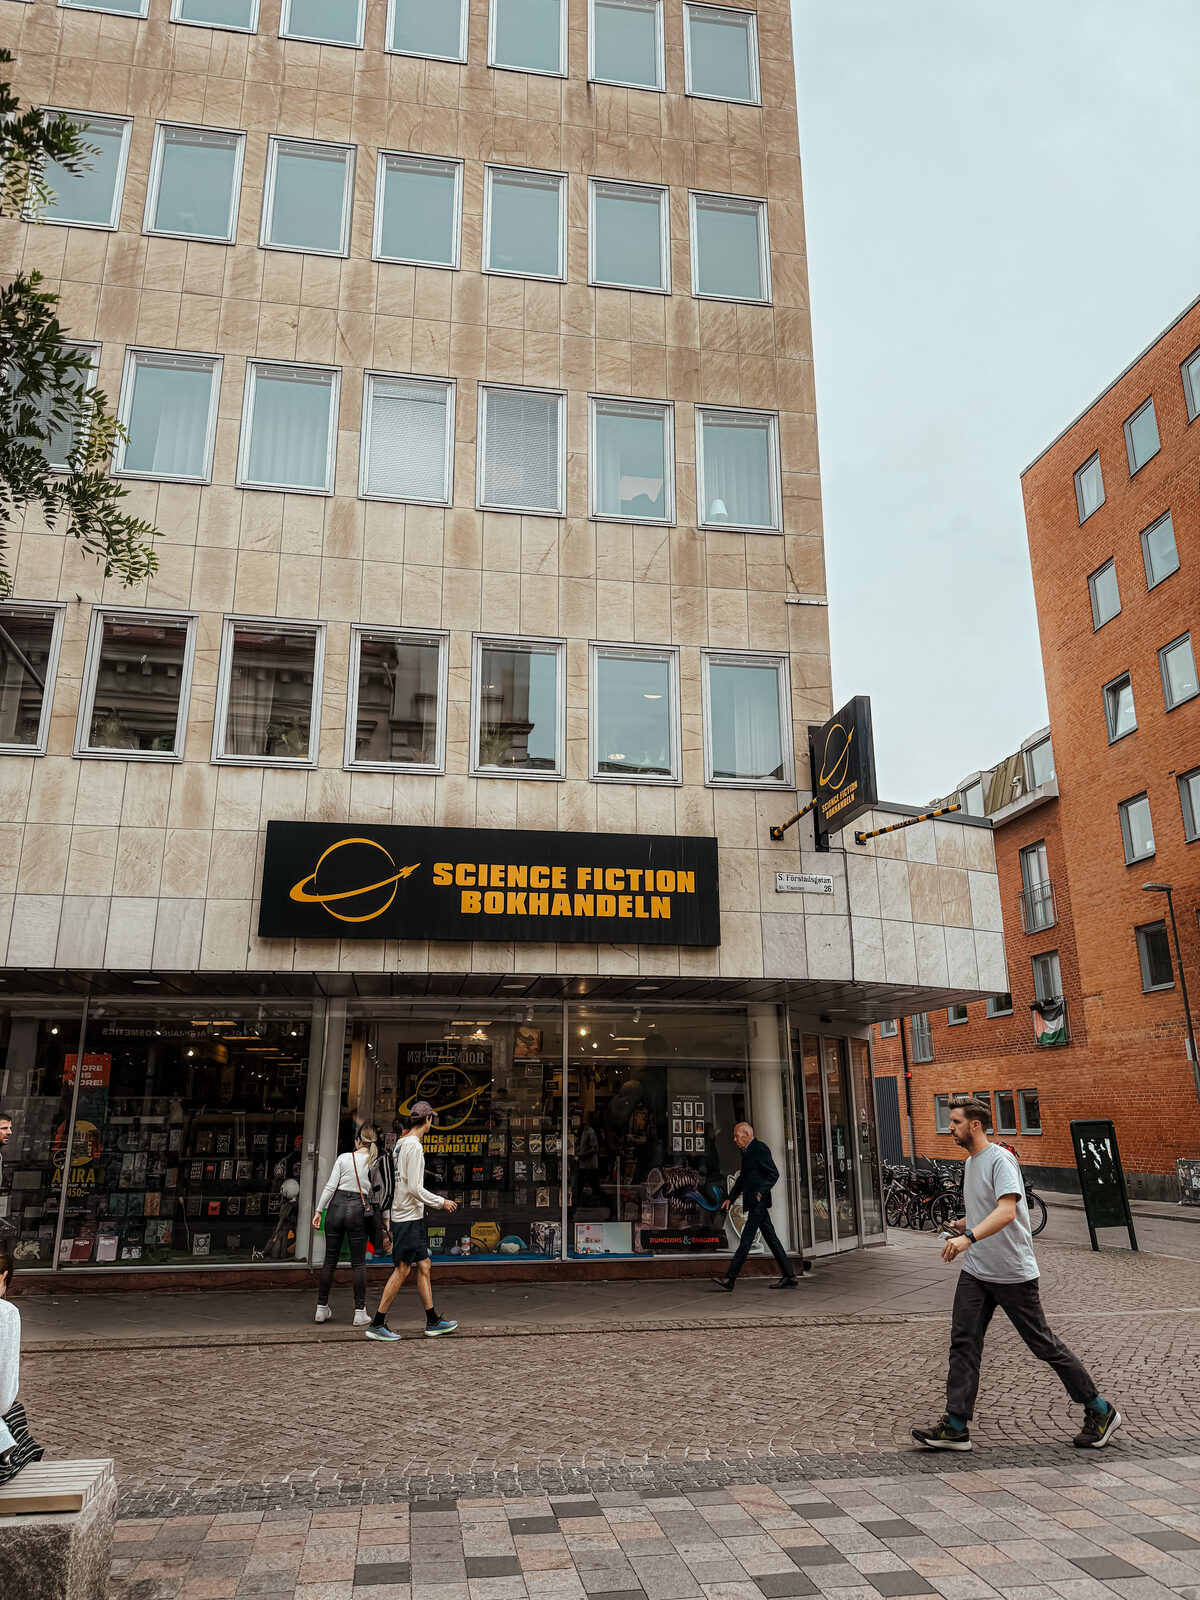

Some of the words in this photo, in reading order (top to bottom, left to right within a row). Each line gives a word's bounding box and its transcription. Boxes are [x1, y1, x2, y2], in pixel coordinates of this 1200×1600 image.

[822, 793, 840, 813] SCIENCE
[839, 779, 858, 800] FICTION
[825, 791, 855, 820] BOKHANDELN
[432, 861, 567, 889] SCIENCE
[576, 866, 696, 894] FICTION
[777, 873, 785, 882] S.
[786, 874, 832, 884] Förstadsgatan
[823, 885, 832, 893] 26
[460, 890, 672, 919] BOKHANDELN
[446, 1134, 488, 1144] FICTION
[423, 1144, 479, 1153] KHANDELN
[51, 1167, 96, 1184] AIRA
[649, 1236, 683, 1244] DUNGEONS
[682, 1234, 692, 1246] &
[691, 1236, 720, 1244] DRAGONS
